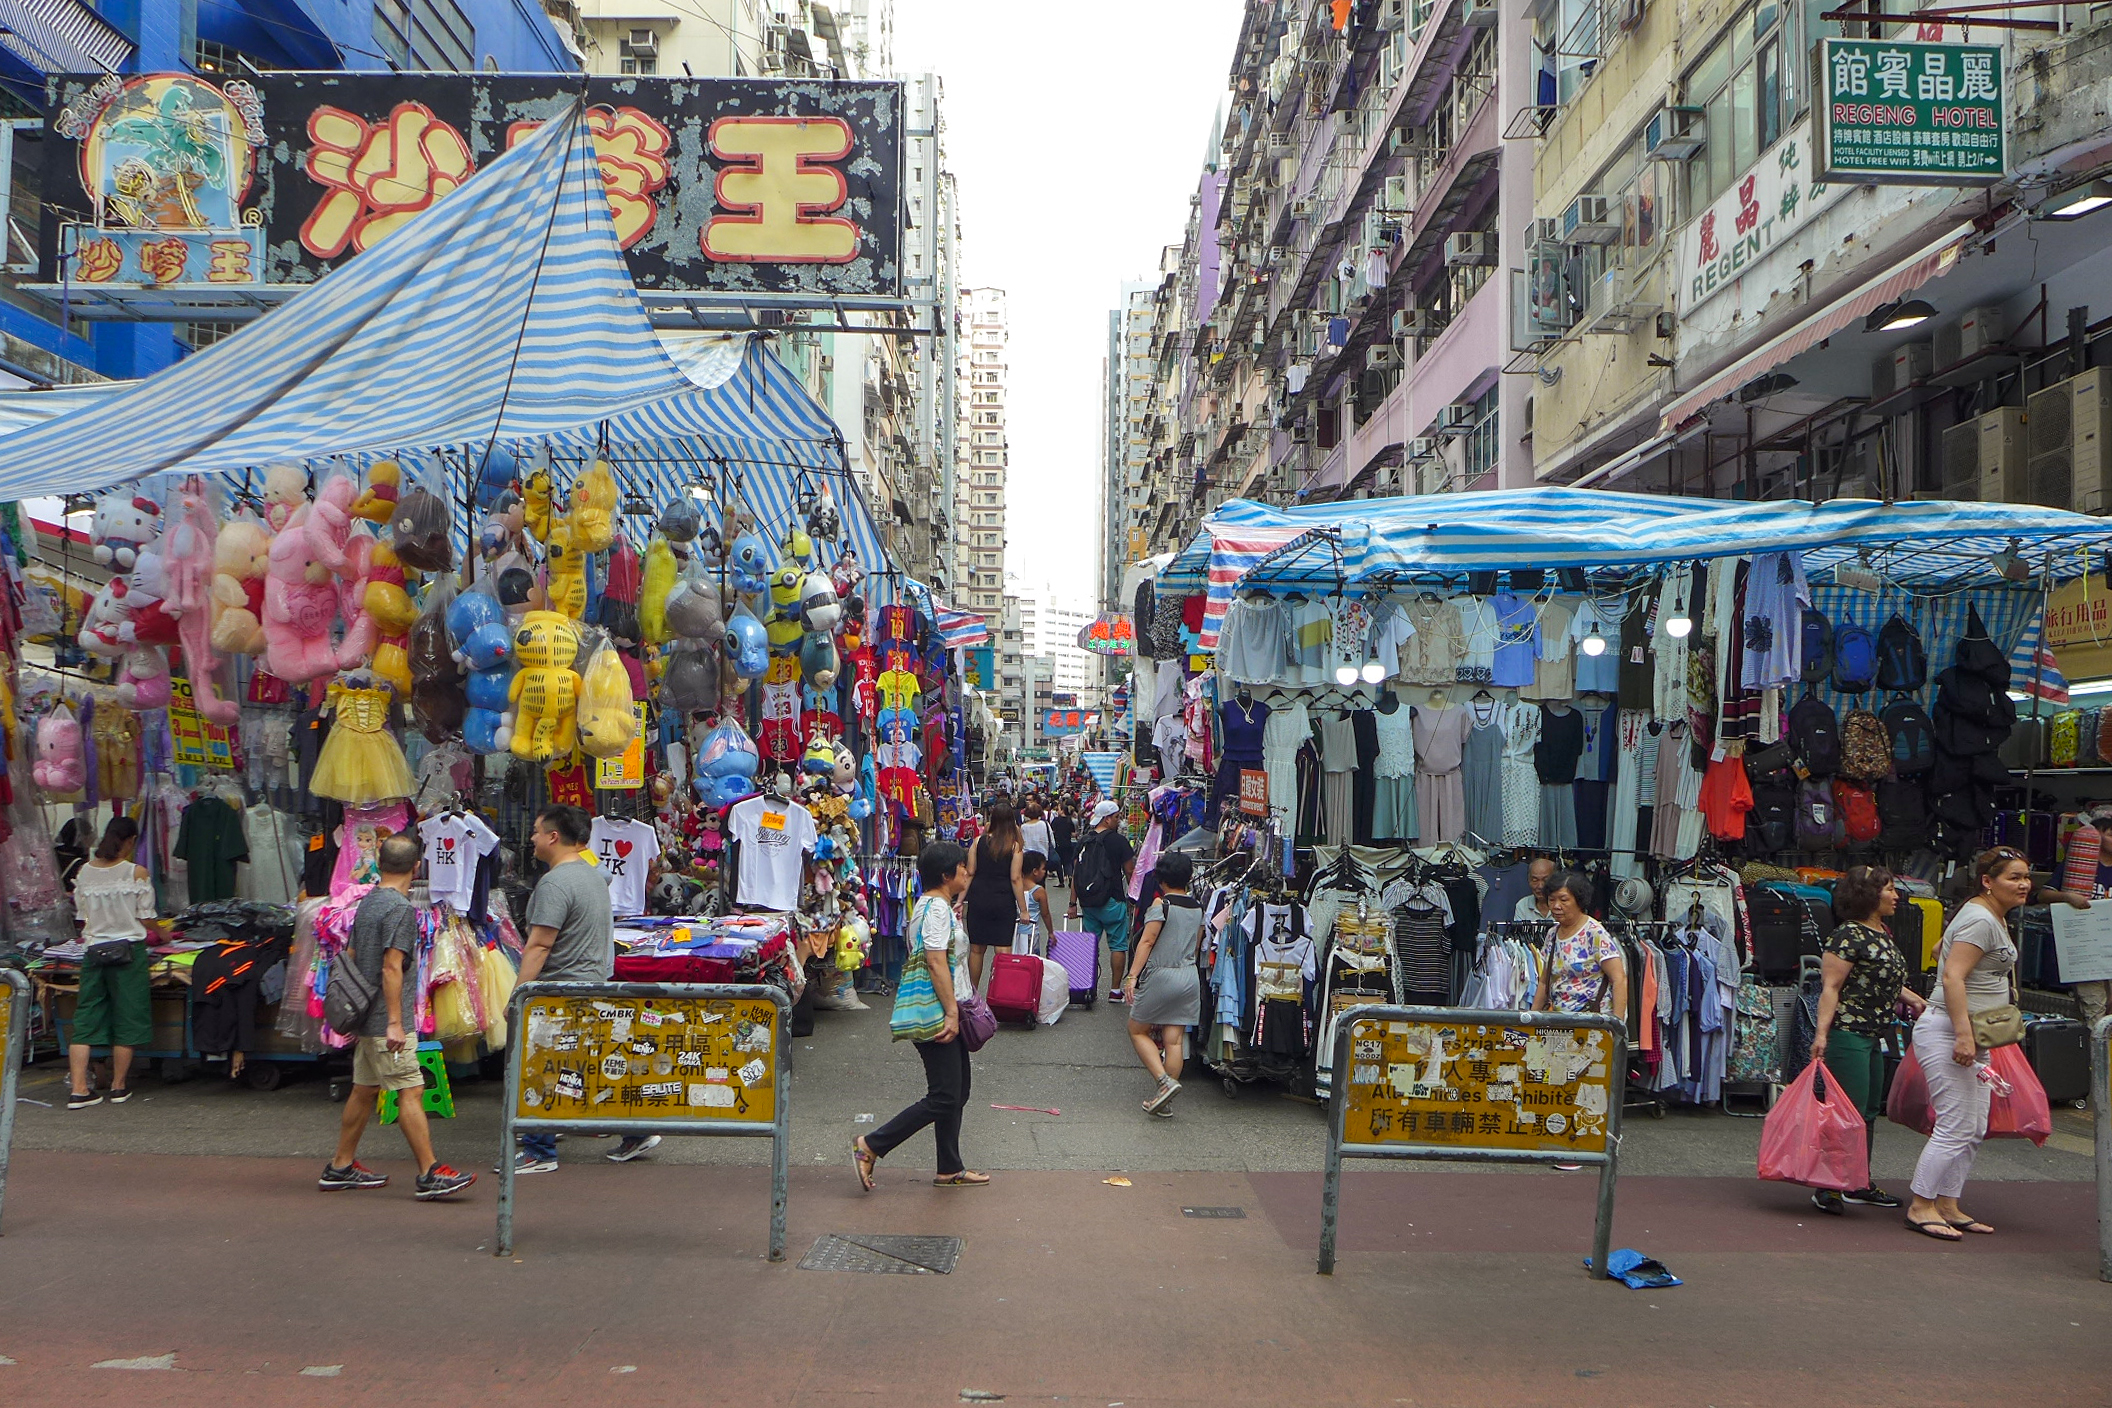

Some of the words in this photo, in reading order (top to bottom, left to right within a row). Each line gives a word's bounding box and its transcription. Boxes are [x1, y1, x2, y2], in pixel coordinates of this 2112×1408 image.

[1833, 103, 1917, 126] REGENG
[1932, 107, 1998, 129] HOTEL
[1833, 129, 1872, 144] 持牌賓館
[1834, 147, 1855, 155] HOTEL
[1856, 148, 1882, 156] FACILITY
[1834, 156, 1864, 165] HOTEL
[1867, 157, 1888, 166] FREE
[1889, 158, 1910, 166] WIFI
[1692, 216, 1775, 302] REGENT
[172, 719, 181, 735] 3
[436, 837, 443, 851] I
[601, 838, 613, 857] I
[436, 851, 456, 865] HK
[599, 1010, 634, 1018] CMBK
[752, 1005, 774, 1019] HARE
[1356, 1040, 1381, 1048] NC17
[678, 1051, 702, 1060] 24K
[604, 1059, 626, 1068] XEME
[641, 1081, 682, 1096] SAUTE
